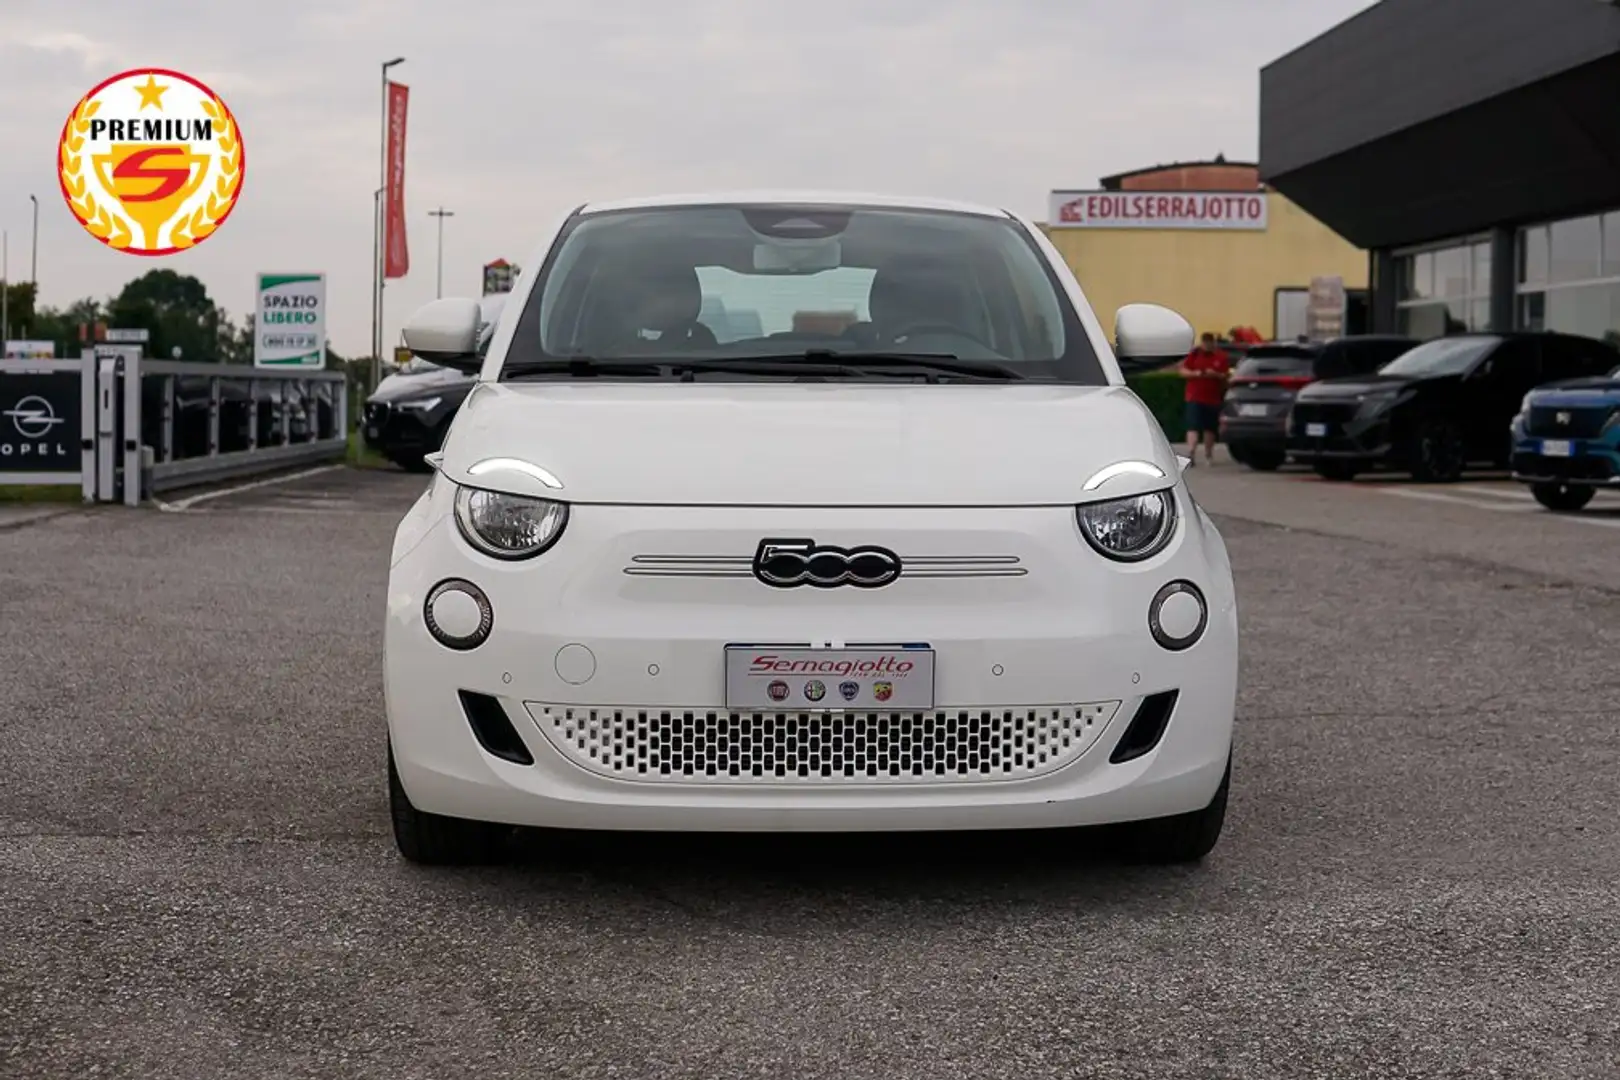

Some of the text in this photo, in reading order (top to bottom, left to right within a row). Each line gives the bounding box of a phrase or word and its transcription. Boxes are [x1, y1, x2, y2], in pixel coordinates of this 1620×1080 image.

[1087, 196, 1261, 219] EDILSERRAJOTTO
[263, 295, 318, 309] SPAZIO
[263, 311, 317, 325] LIBERO
[1, 443, 66, 456] OPEL
[752, 538, 903, 588] 500
[750, 656, 914, 676] Sernagiotto
